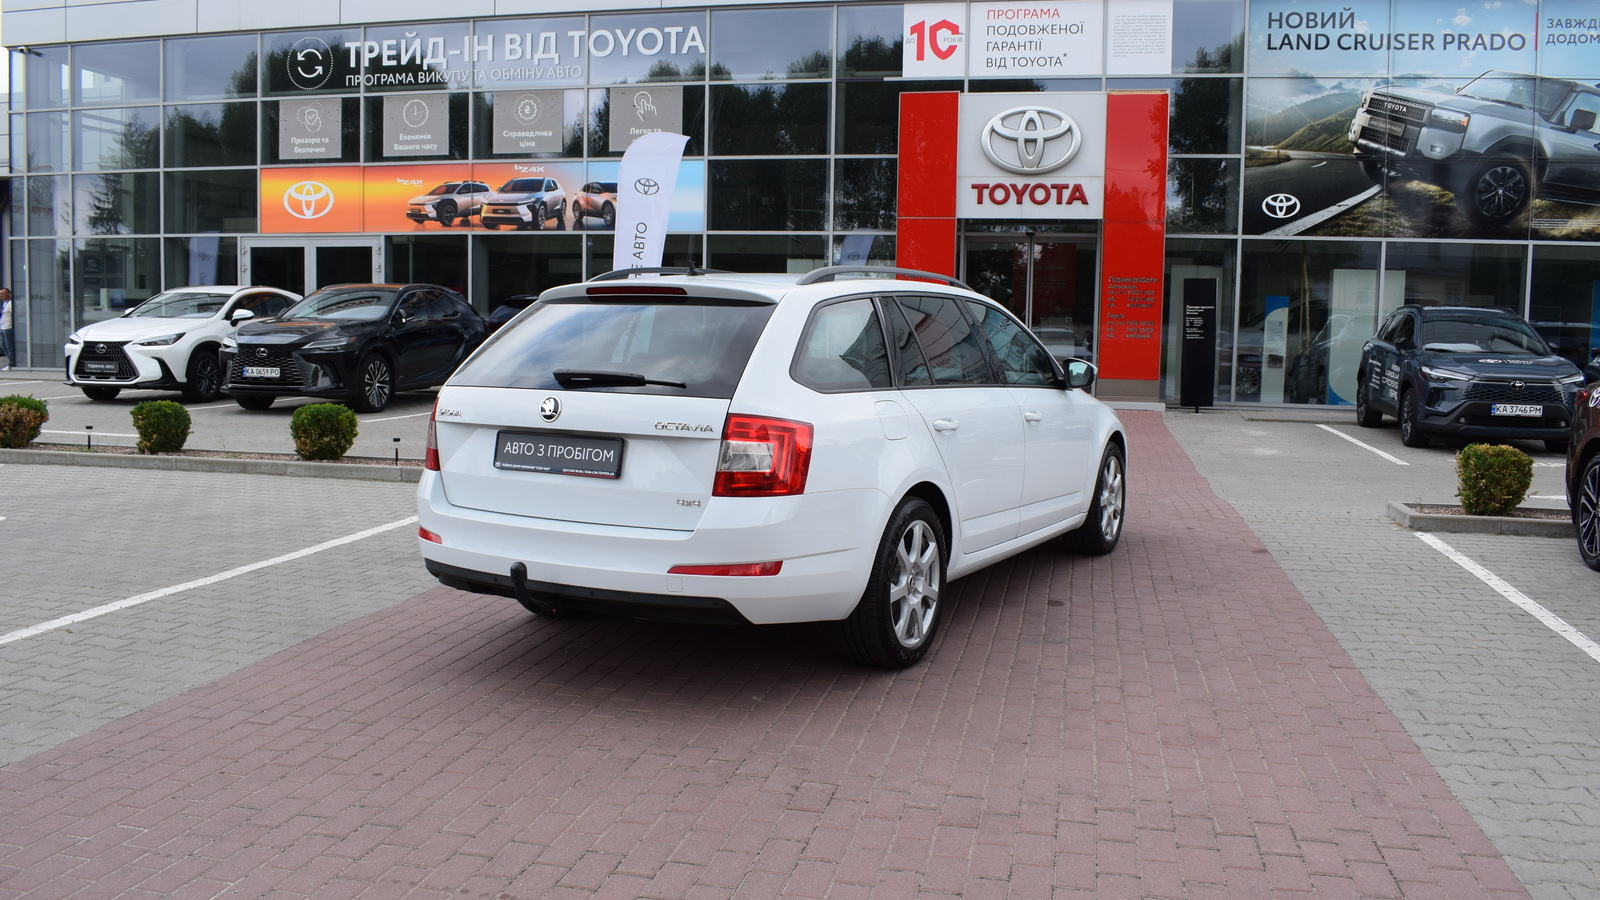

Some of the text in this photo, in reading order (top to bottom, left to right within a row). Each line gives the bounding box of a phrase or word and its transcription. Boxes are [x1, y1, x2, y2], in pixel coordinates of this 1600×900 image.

[986, 8, 1060, 20] ПРОГРАМА
[1268, 7, 1355, 29] НОВИЙ
[986, 21, 1085, 37] ПОДОВЖЕНОЇ
[1546, 18, 1600, 30] ЗАВЖД
[910, 19, 960, 61] 10
[986, 38, 1043, 52] ГАРАНТІЇ
[1267, 33, 1526, 51] LAND CRUISER PRADO
[344, 26, 706, 70] ТРЕЙД-ІН ВІД TOYOTA
[986, 57, 1008, 70] ВІД
[345, 65, 583, 87] ПРОГРАМА ВИКУПУ ТА ОБМІНУ АВТО
[1384, 102, 1407, 112] TOYOTA
[291, 136, 320, 145] Прозоро
[400, 132, 432, 142] Економія
[502, 130, 552, 138] Справедлива
[394, 143, 438, 152] Вашого часу
[520, 140, 536, 148] ціна
[971, 183, 1089, 206] TOYOTA
[633, 222, 648, 260] АВТО
[1382, 376, 1399, 389] CROSS
[1509, 406, 1528, 414] 3746
[654, 422, 714, 433] OCTAVIA
[504, 442, 614, 462] АВТО З ПРОБІГОМ
[676, 499, 701, 507] 4x4
